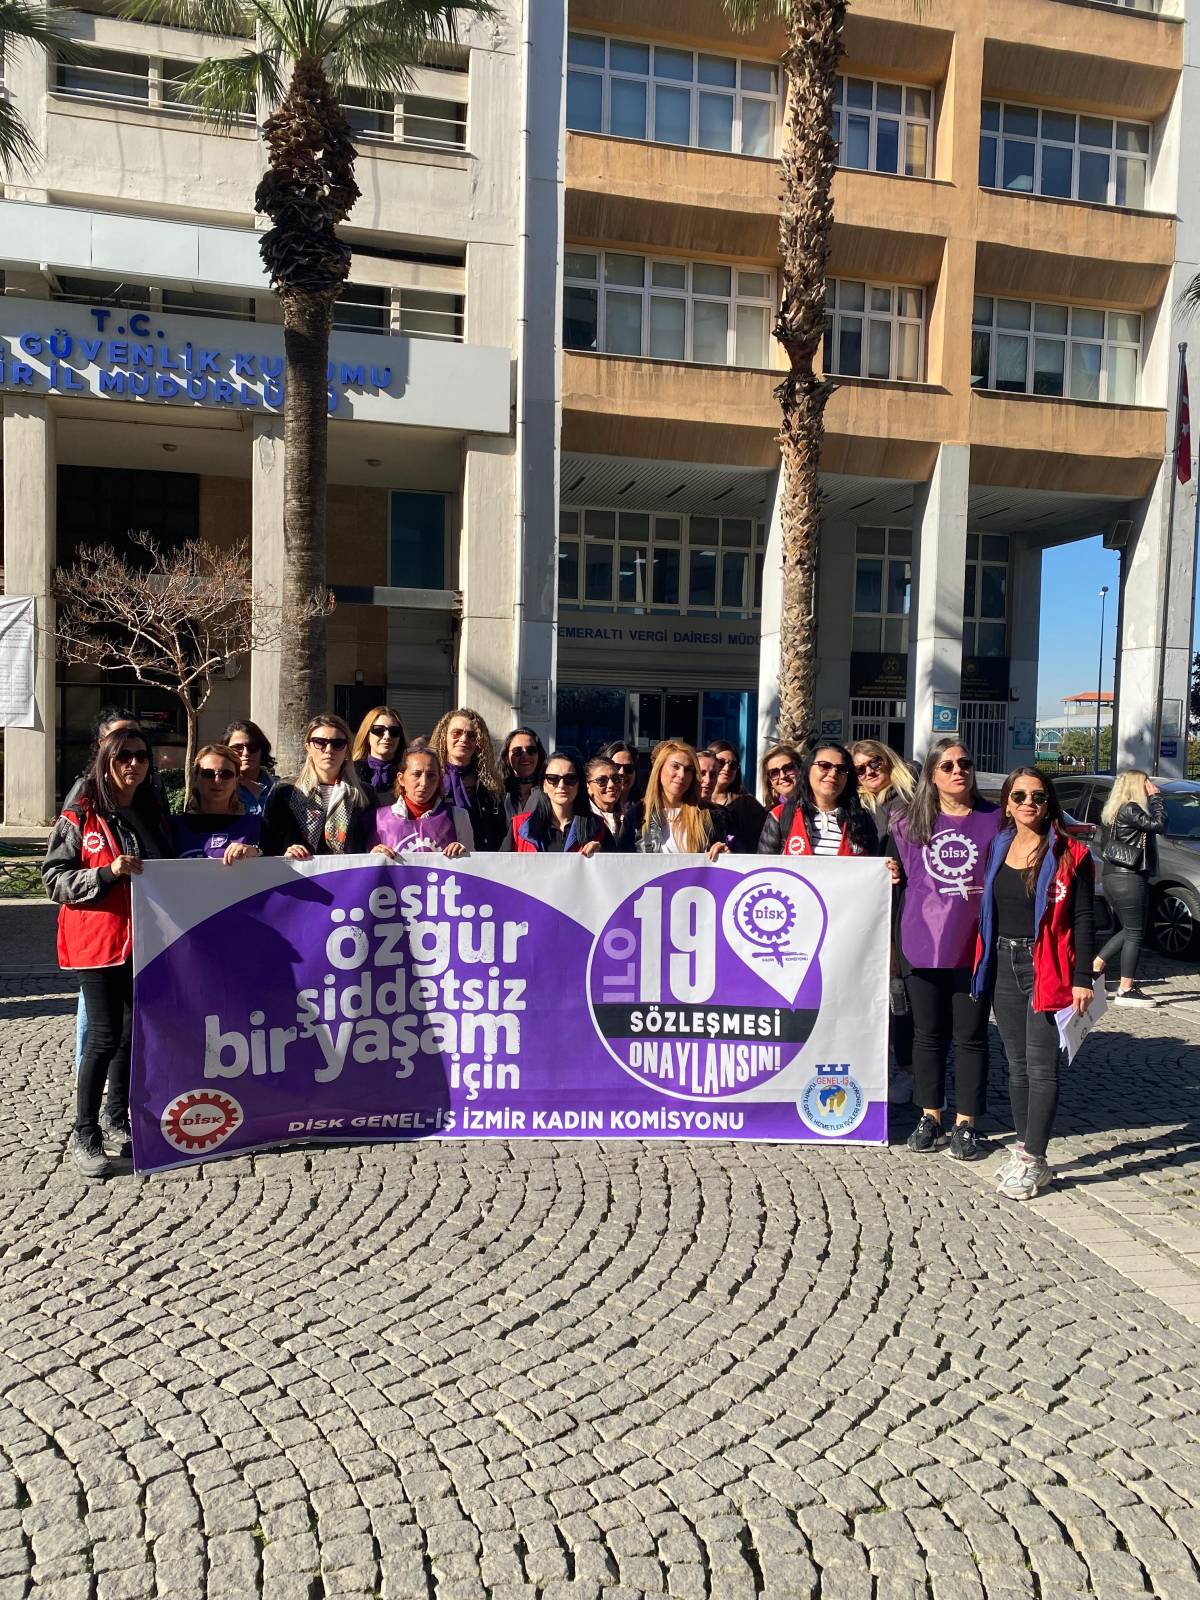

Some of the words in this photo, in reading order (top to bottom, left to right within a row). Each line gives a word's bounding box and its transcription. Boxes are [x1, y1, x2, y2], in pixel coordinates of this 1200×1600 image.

[91, 308, 165, 338] T.C.
[19, 328, 220, 373] GÜVENLİK
[235, 352, 392, 389] KUMU
[50, 360, 83, 390] İL
[99, 367, 337, 412] MÜDÜRLÜ
[629, 629, 668, 643] VERGİ
[673, 631, 722, 644] DAİRESİ
[941, 847, 968, 858] DİSK
[368, 872, 462, 926] eşit
[755, 906, 784, 919] DİSK
[326, 905, 529, 977] özgür
[603, 928, 636, 1002] ILO
[634, 886, 716, 1004] 19
[296, 967, 526, 1038] şiddetsiz
[630, 1006, 781, 1038] SÖZLEŞMESİ
[203, 1010, 297, 1079] bir
[314, 1012, 520, 1083] yaşam
[629, 1041, 781, 1094] ONAYLANSIN!
[451, 1053, 520, 1100] için
[182, 1113, 223, 1126] DİSK
[288, 1118, 344, 1131] DİSK
[351, 1107, 456, 1132] GENEL-İŞ
[463, 1107, 526, 1129] İZMİR
[532, 1111, 603, 1129] KADIN
[610, 1107, 744, 1130] KOMİSYONU
